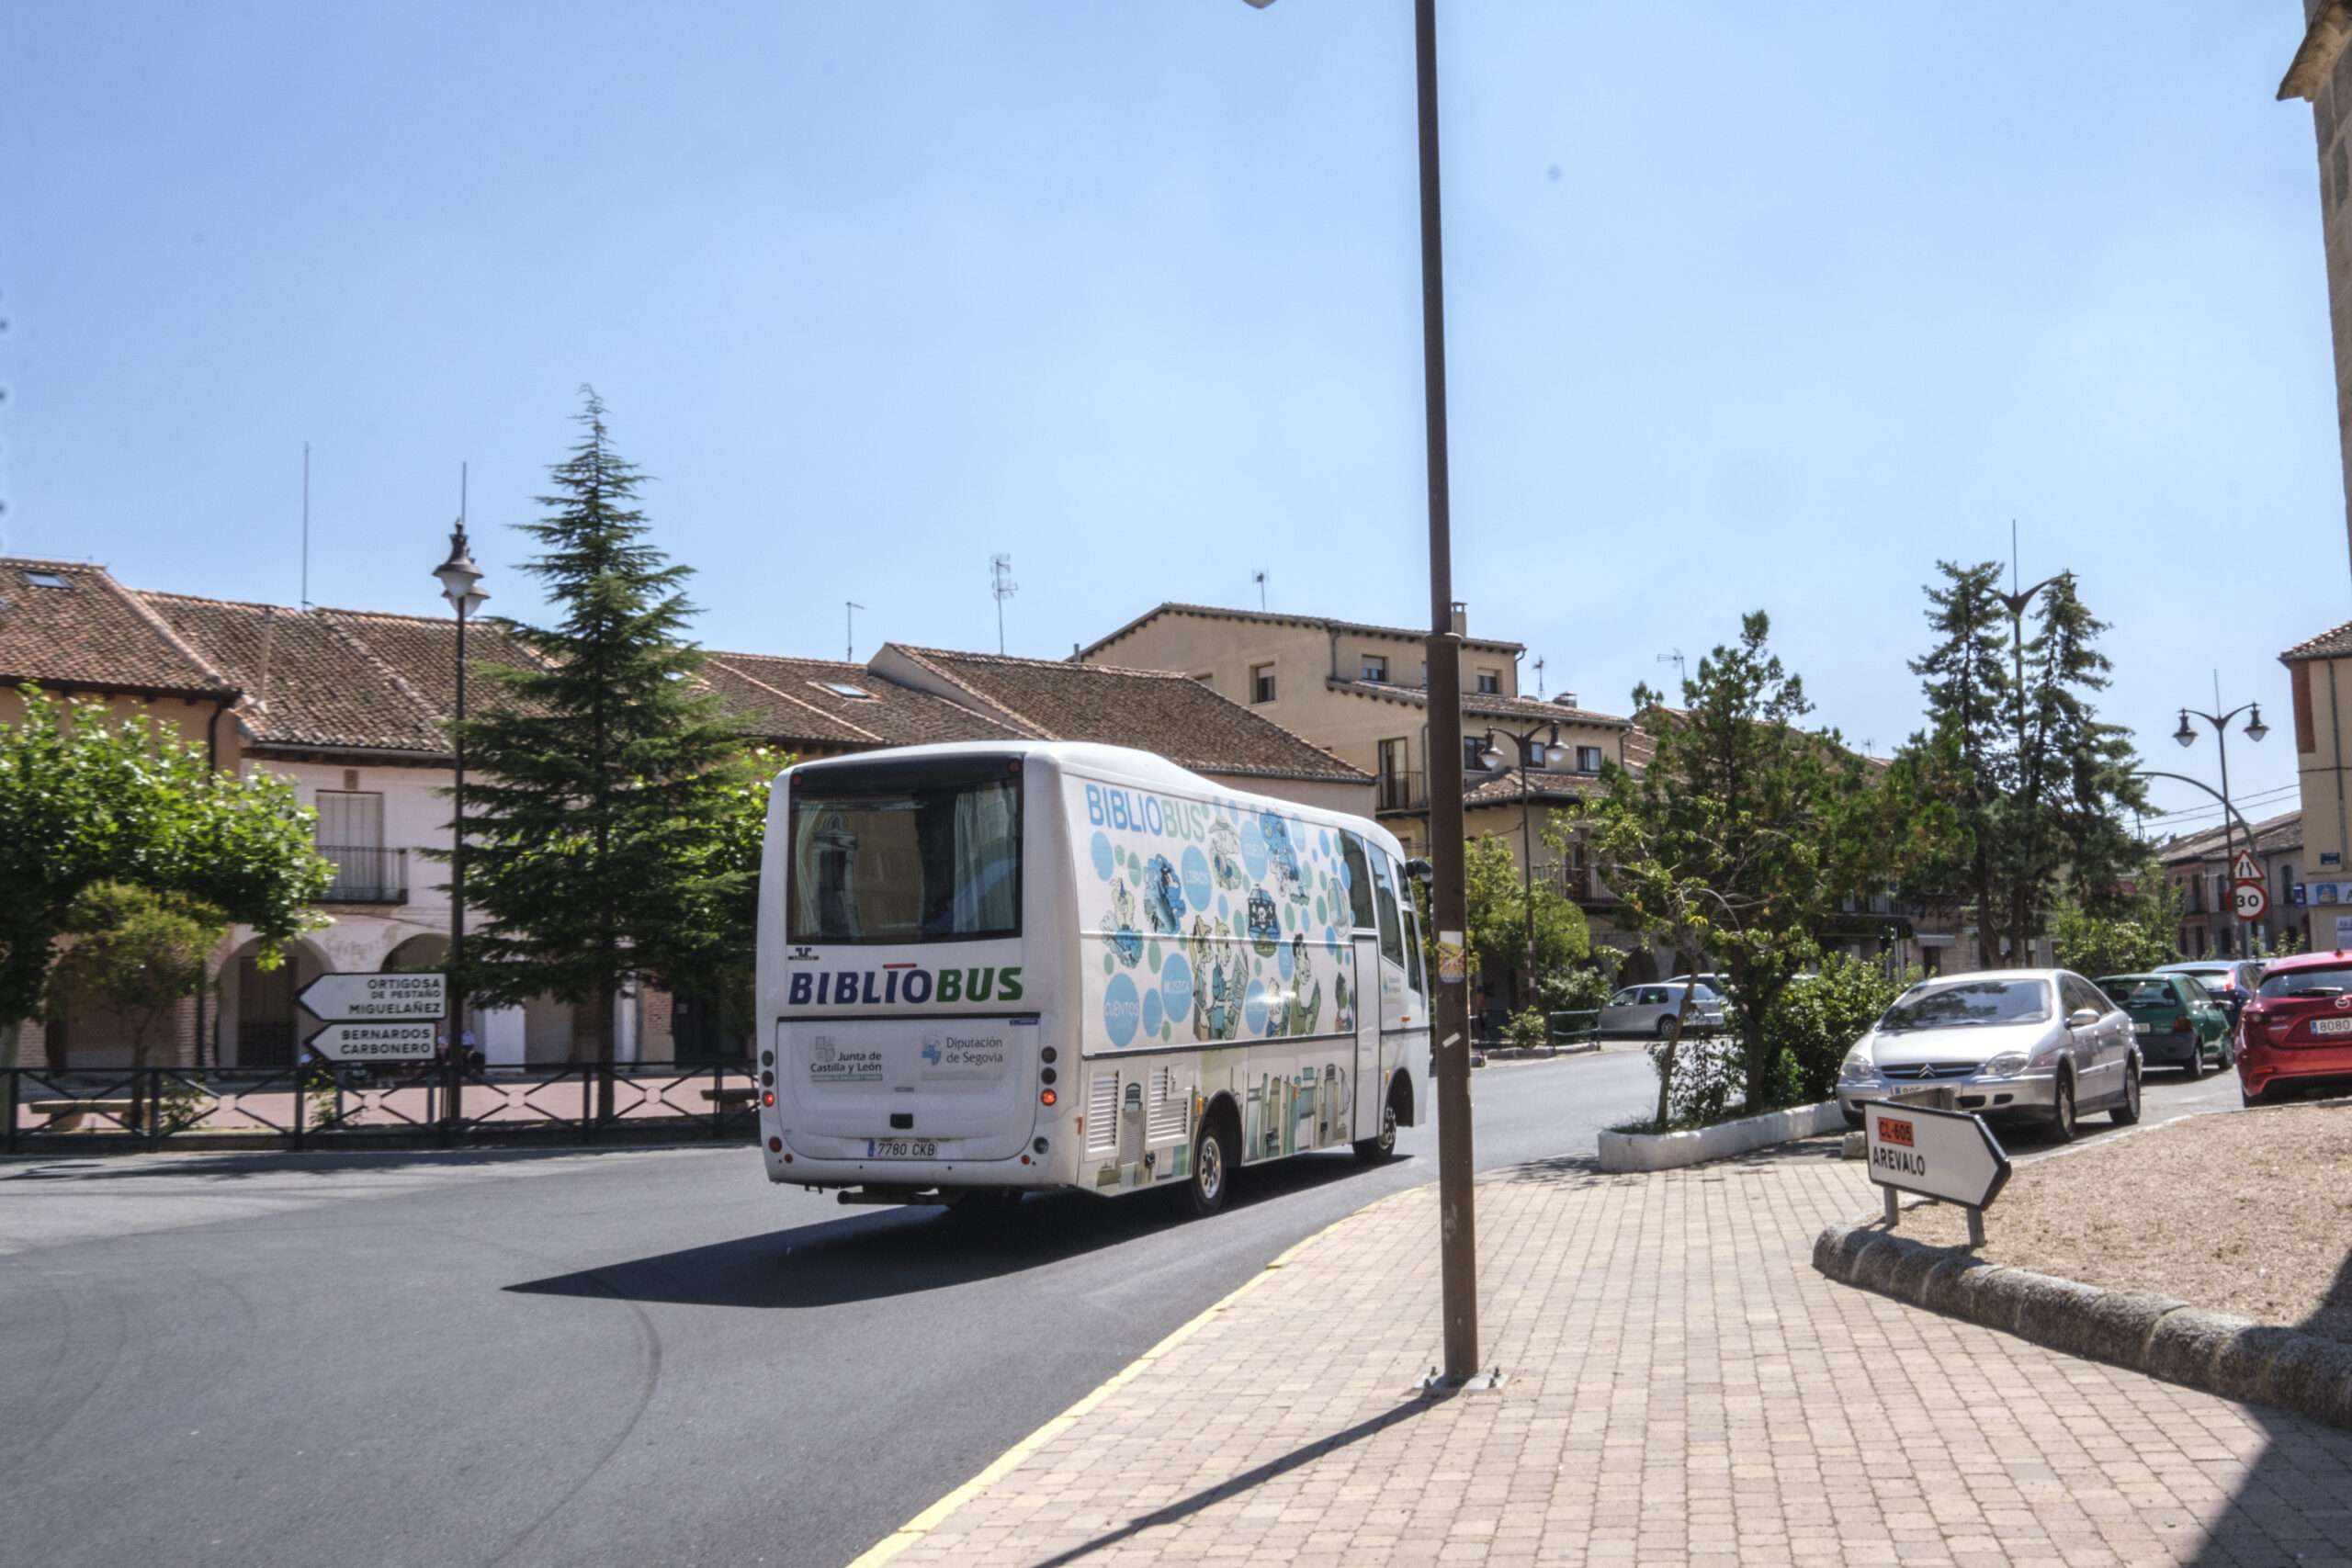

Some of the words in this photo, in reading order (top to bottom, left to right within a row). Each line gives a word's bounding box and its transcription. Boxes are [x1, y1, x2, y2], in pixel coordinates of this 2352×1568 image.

[1086, 784, 1205, 842] BIBLIOBUS
[2235, 894, 2259, 908] 30
[368, 978, 441, 989] ORTIGOSA
[788, 967, 1023, 1005] BIBLIOBUS
[371, 991, 385, 999] DE
[391, 988, 441, 998] PESTAÑO
[348, 1000, 441, 1014] MIGUELAÑEZ
[2320, 1021, 2351, 1032] 8080
[341, 1029, 431, 1041] BERNARDOS
[340, 1043, 430, 1055] CARBONERO
[946, 1036, 1003, 1050] Diputación
[838, 1052, 866, 1062] Junta
[868, 1051, 882, 1061] de
[946, 1052, 960, 1063] de
[963, 1051, 1003, 1066] Segovia
[810, 1063, 846, 1073] Castilla
[848, 1065, 854, 1074] y
[857, 1063, 882, 1072] León
[1880, 1121, 1912, 1141] CL-605
[878, 1143, 907, 1156] 7780
[912, 1143, 935, 1156] CKB
[1873, 1146, 1925, 1175] AREVALO
